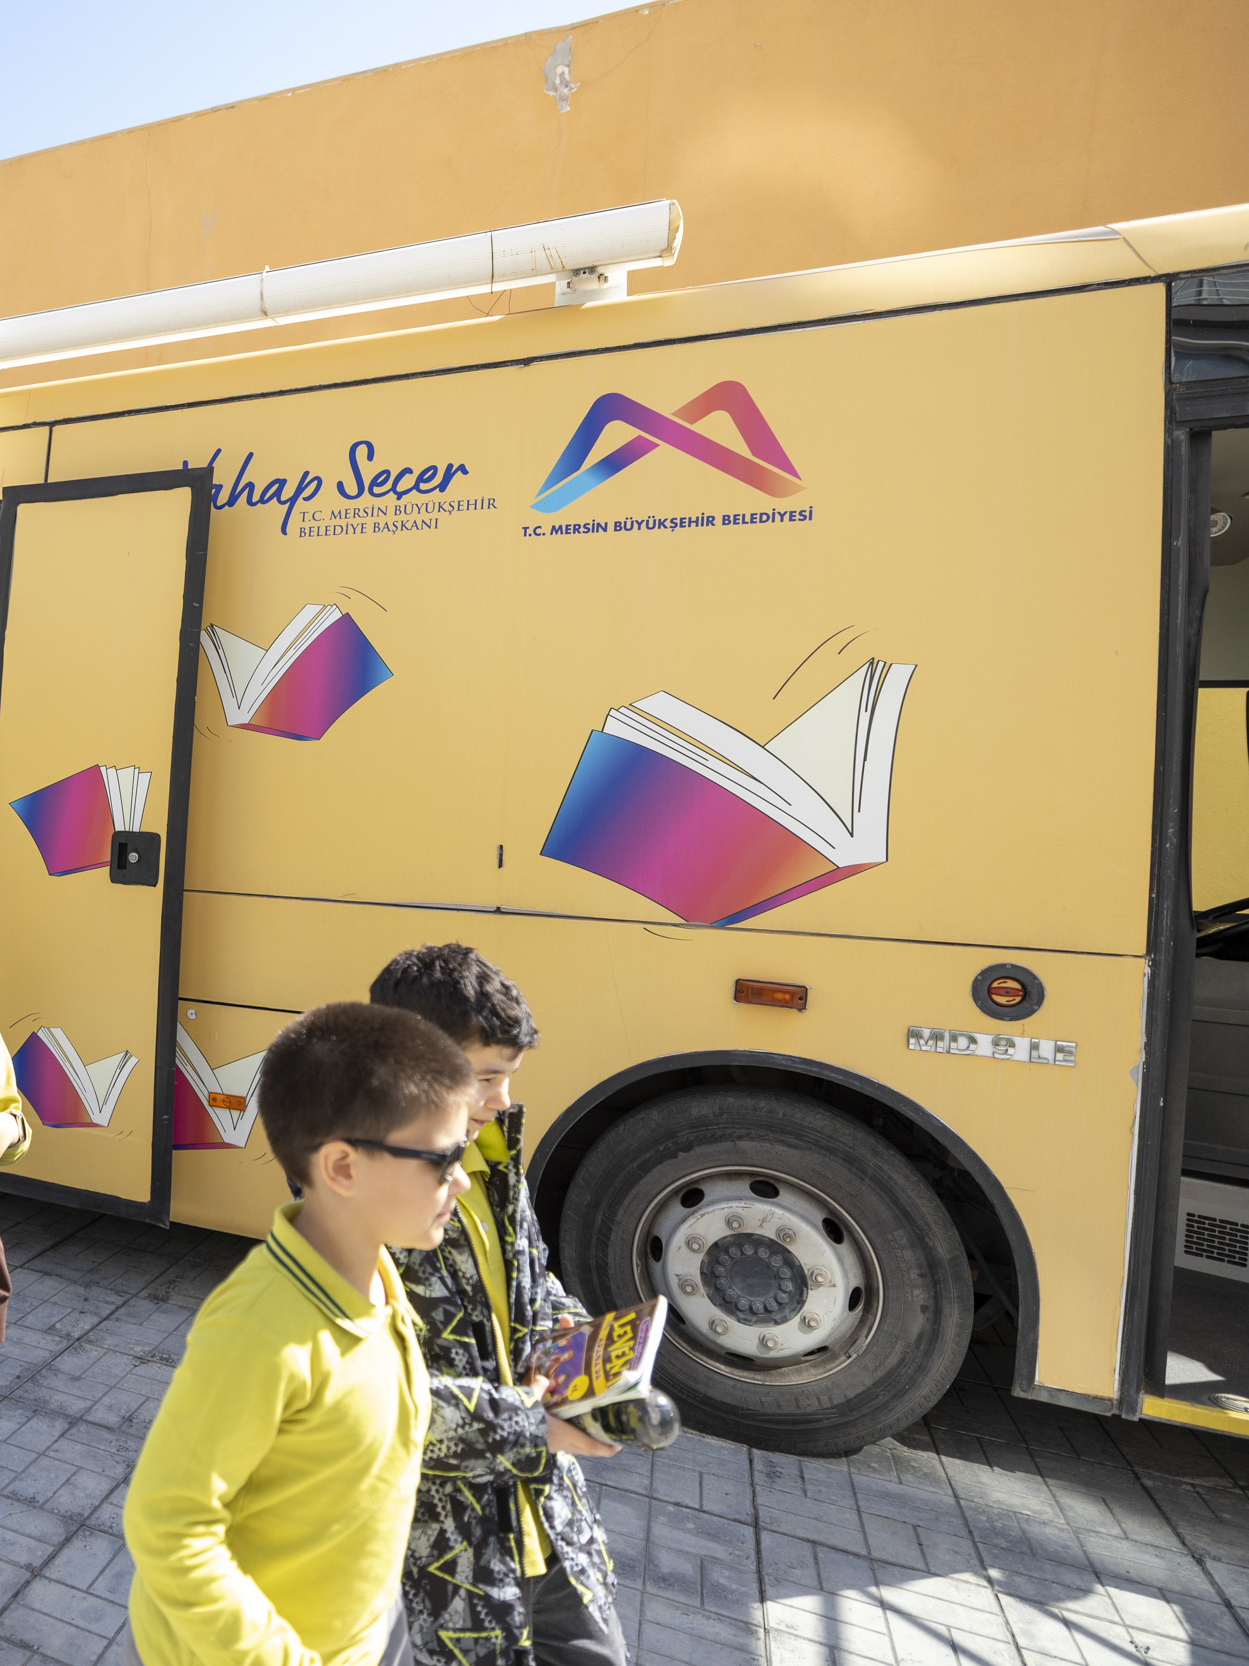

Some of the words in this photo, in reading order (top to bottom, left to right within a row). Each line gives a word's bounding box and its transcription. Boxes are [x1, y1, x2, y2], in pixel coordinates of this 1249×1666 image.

[336, 439, 469, 501] Seçer
[299, 510, 325, 523] T.C.
[329, 504, 389, 521] MERSİN
[393, 496, 498, 516] BÜYÜKŞEHİR
[522, 525, 547, 537] T.C.
[550, 518, 608, 536] MERSİN
[613, 512, 717, 533] BÜYÜKŞEHİR
[721, 506, 814, 527] BELEDİYESİ
[298, 521, 368, 538] BELEDİYE
[372, 517, 440, 536] BAŞKANI
